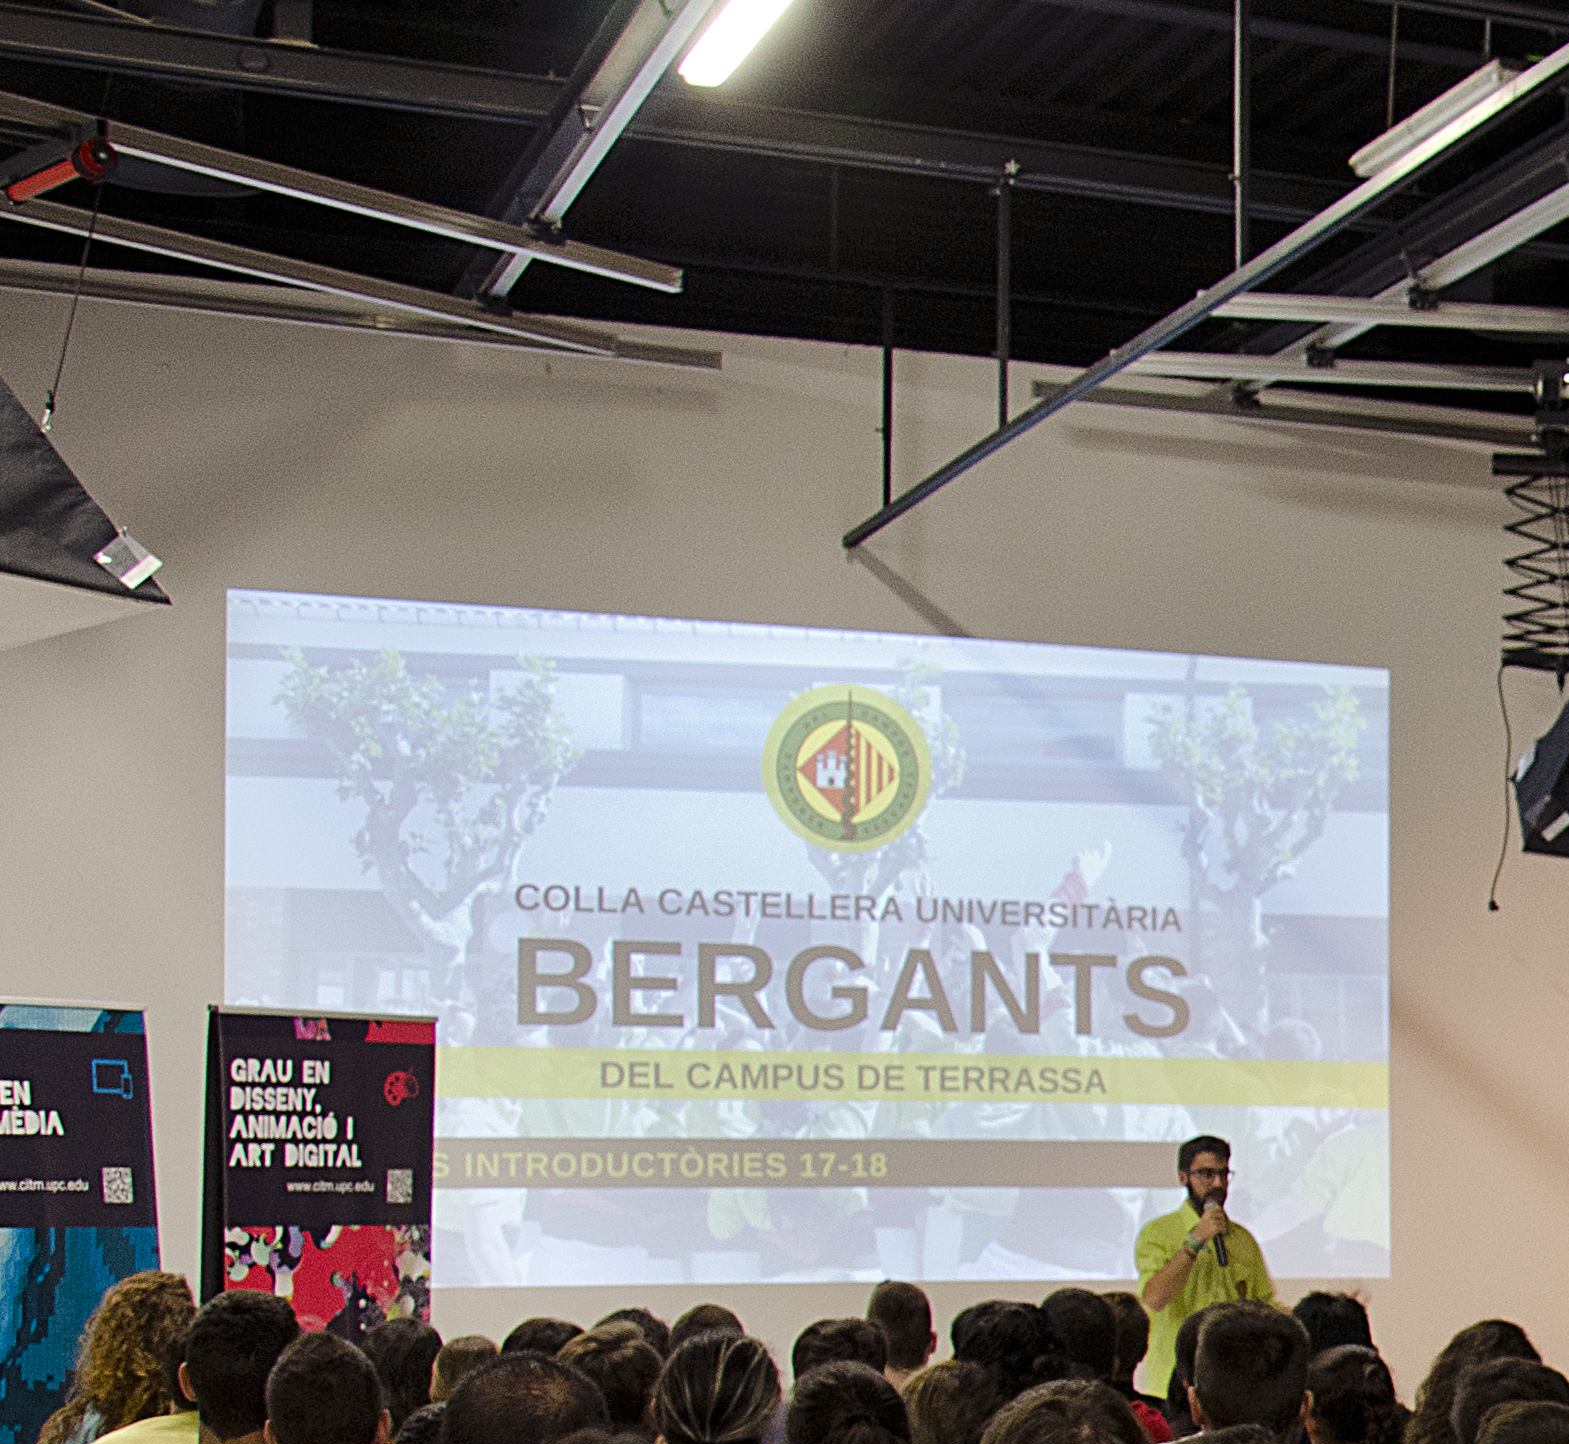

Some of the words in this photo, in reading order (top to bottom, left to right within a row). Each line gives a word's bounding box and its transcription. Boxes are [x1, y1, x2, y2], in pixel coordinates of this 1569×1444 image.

[515, 883, 645, 914] COLLA
[658, 888, 903, 923] CASTELLERA
[915, 898, 1183, 932] UNIVERSITÀRIA
[517, 937, 1191, 1040] BERGANTS
[230, 1058, 293, 1083] GRAU
[302, 1060, 330, 1085] EN
[600, 1062, 674, 1089] DEL
[686, 1063, 845, 1091] CAMPUS
[857, 1065, 904, 1092] DE
[916, 1066, 1107, 1094] TERRASSA
[0, 1080, 31, 1106] EN
[229, 1086, 322, 1114] DISSENY,
[0, 1106, 65, 1136] MÈDIA
[229, 1112, 338, 1140] ANIMACIÓ
[346, 1116, 354, 1140] I
[229, 1143, 275, 1167] ART
[284, 1143, 362, 1168] DIGITAL
[465, 1146, 788, 1179] INTRODUCTÒRIES
[799, 1152, 888, 1178] 17-18
[0, 1178, 90, 1194] ww.citm.upc.edu
[287, 1180, 375, 1195] www.citm.upc.edu
